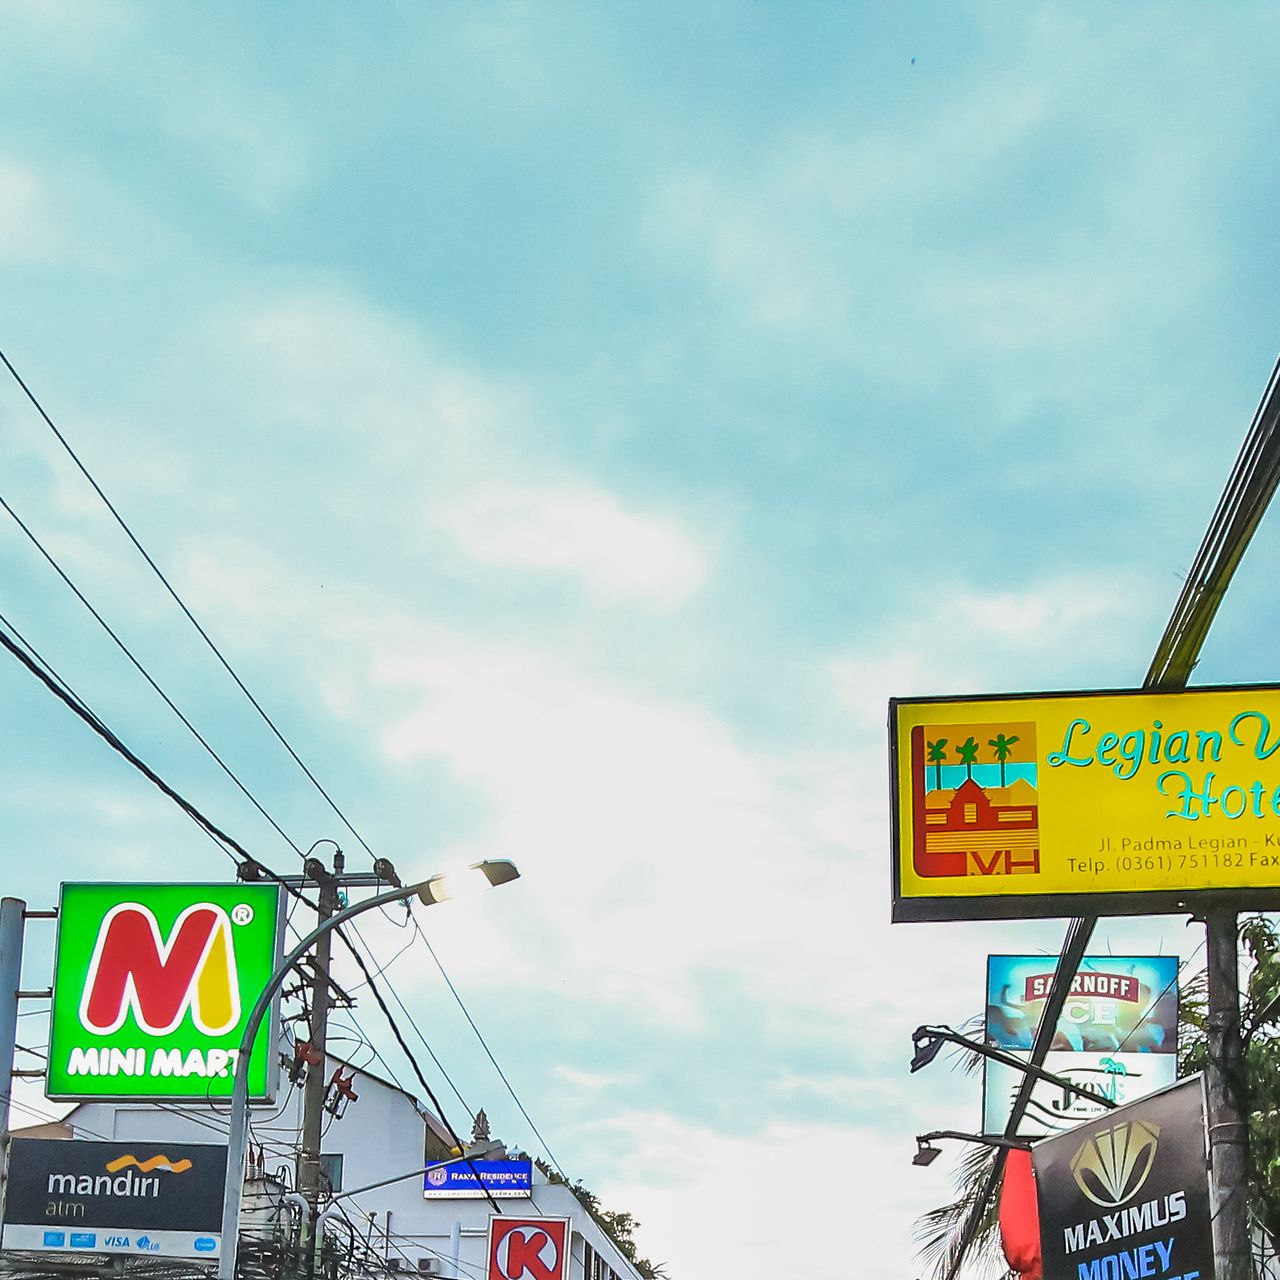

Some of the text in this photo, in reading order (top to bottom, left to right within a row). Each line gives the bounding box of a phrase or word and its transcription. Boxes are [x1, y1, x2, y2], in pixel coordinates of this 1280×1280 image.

[1047, 719, 1222, 779] Legian
[1098, 837, 1117, 853] Jl.
[1122, 836, 1182, 852] Padma
[1189, 835, 1248, 854] Legian
[1067, 858, 1110, 875] Telp.
[1116, 854, 1172, 872] (0361)
[1178, 853, 1243, 870] 751182
[67, 1047, 146, 1077] MINI
[47, 1169, 161, 1198] mandiri
[45, 1200, 85, 1218] atm
[1063, 1189, 1188, 1255] MAXIMUS
[104, 1236, 130, 1248] VISA
